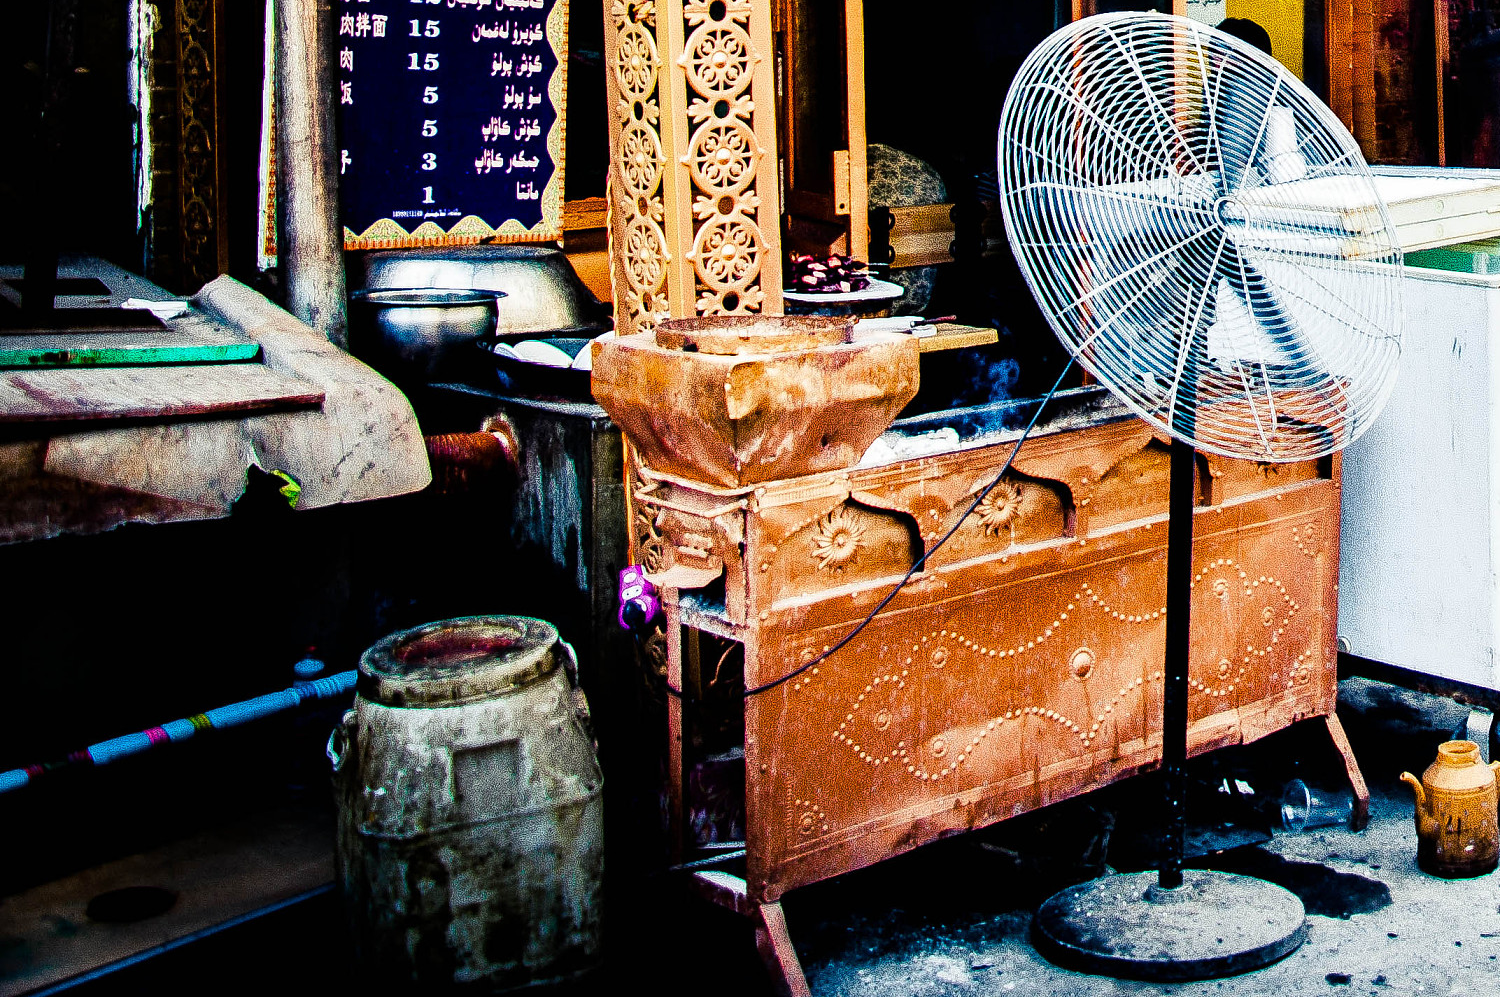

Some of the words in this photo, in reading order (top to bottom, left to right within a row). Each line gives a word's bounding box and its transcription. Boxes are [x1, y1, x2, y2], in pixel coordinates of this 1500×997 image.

[408, 19, 441, 39] 15
[407, 52, 440, 72] 15
[422, 86, 439, 104] 5
[421, 119, 438, 137] 5
[420, 152, 438, 171] 3
[421, 186, 436, 204] 1
